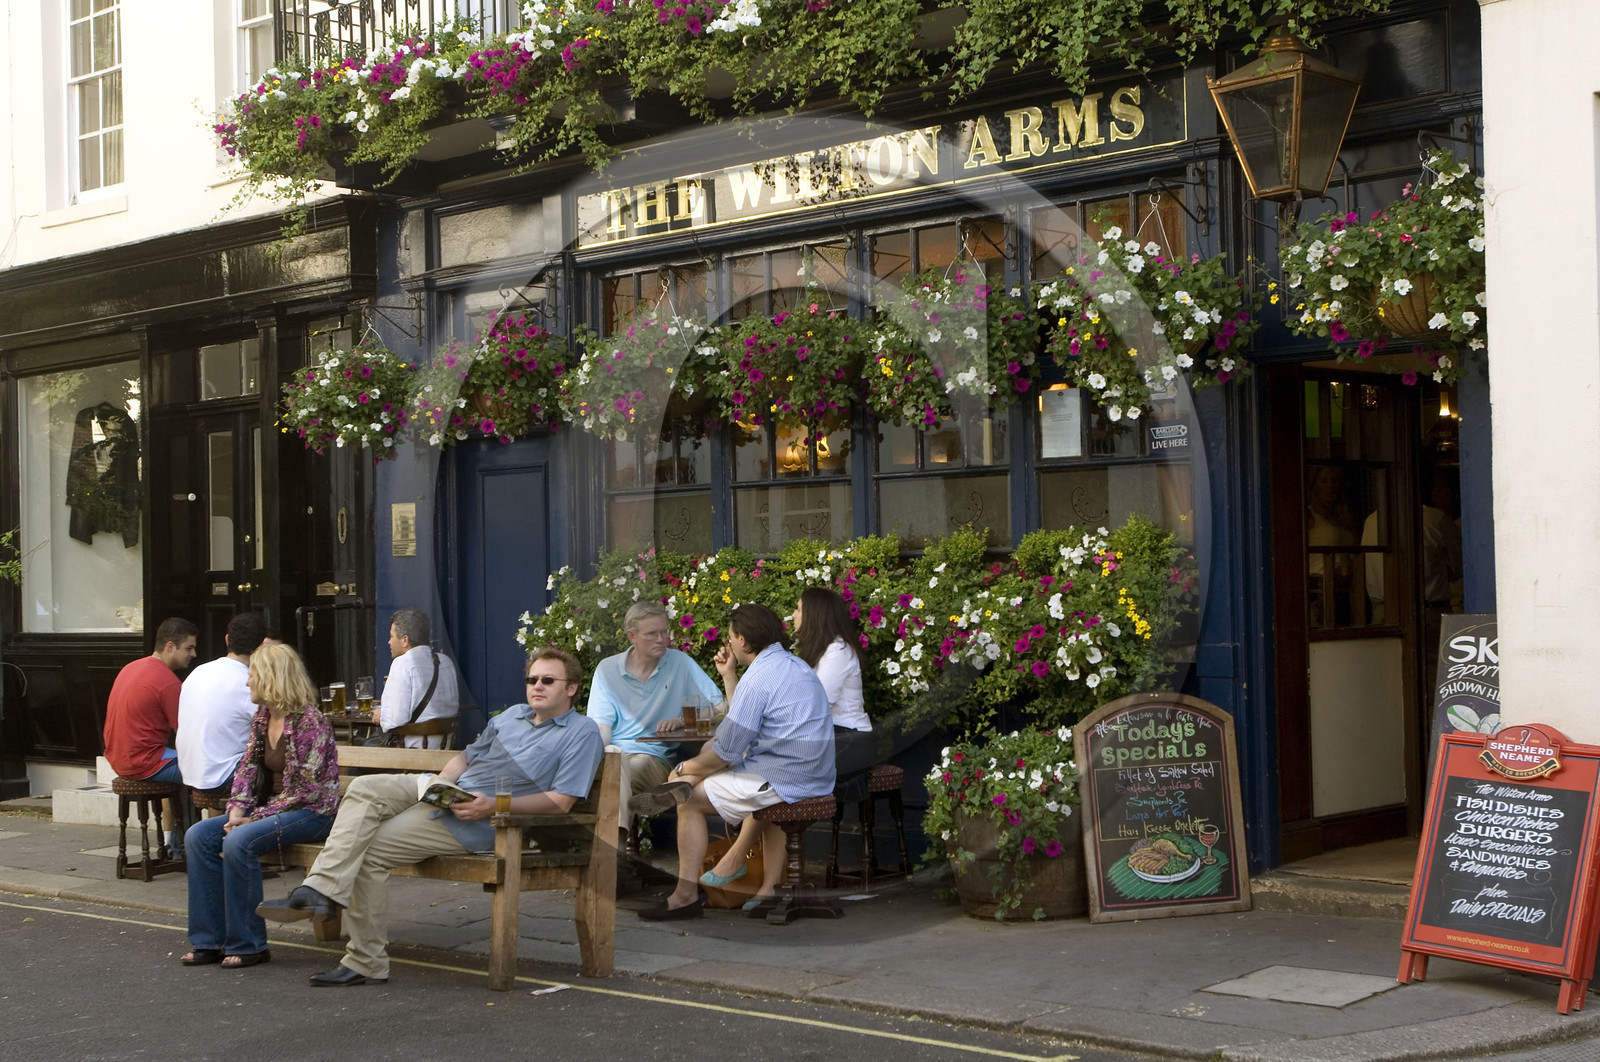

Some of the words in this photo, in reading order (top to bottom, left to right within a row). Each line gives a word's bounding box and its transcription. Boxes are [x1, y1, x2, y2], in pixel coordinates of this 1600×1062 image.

[600, 176, 705, 234] THE
[724, 125, 941, 211] WILTON
[964, 84, 1145, 170] ARMS
[1151, 440, 1168, 450] LIVE
[1168, 437, 1188, 448] HERE
[1438, 681, 1487, 699] SHOWN
[1490, 742, 1554, 757] SHEPHERD
[1500, 751, 1542, 764] NEAME
[1118, 767, 1142, 784] Fillet
[1144, 767, 1157, 784] of
[1190, 761, 1215, 778] Salad
[1475, 783, 1496, 796] The
[1494, 786, 1526, 800] Wilton
[1525, 789, 1554, 802] Arms
[1456, 795, 1493, 811] FISH
[1494, 801, 1565, 819] DISHES
[1454, 810, 1513, 826] Chicken
[1512, 815, 1560, 831] Dishes
[1443, 832, 1481, 848] House
[1456, 822, 1553, 845] BURGERS
[1445, 846, 1552, 870] SANDWICHES
[1449, 898, 1485, 918] Daily
[1480, 901, 1547, 924] SPECIALS
[1446, 934, 1530, 954] www.shepherd-neame.co.uk
